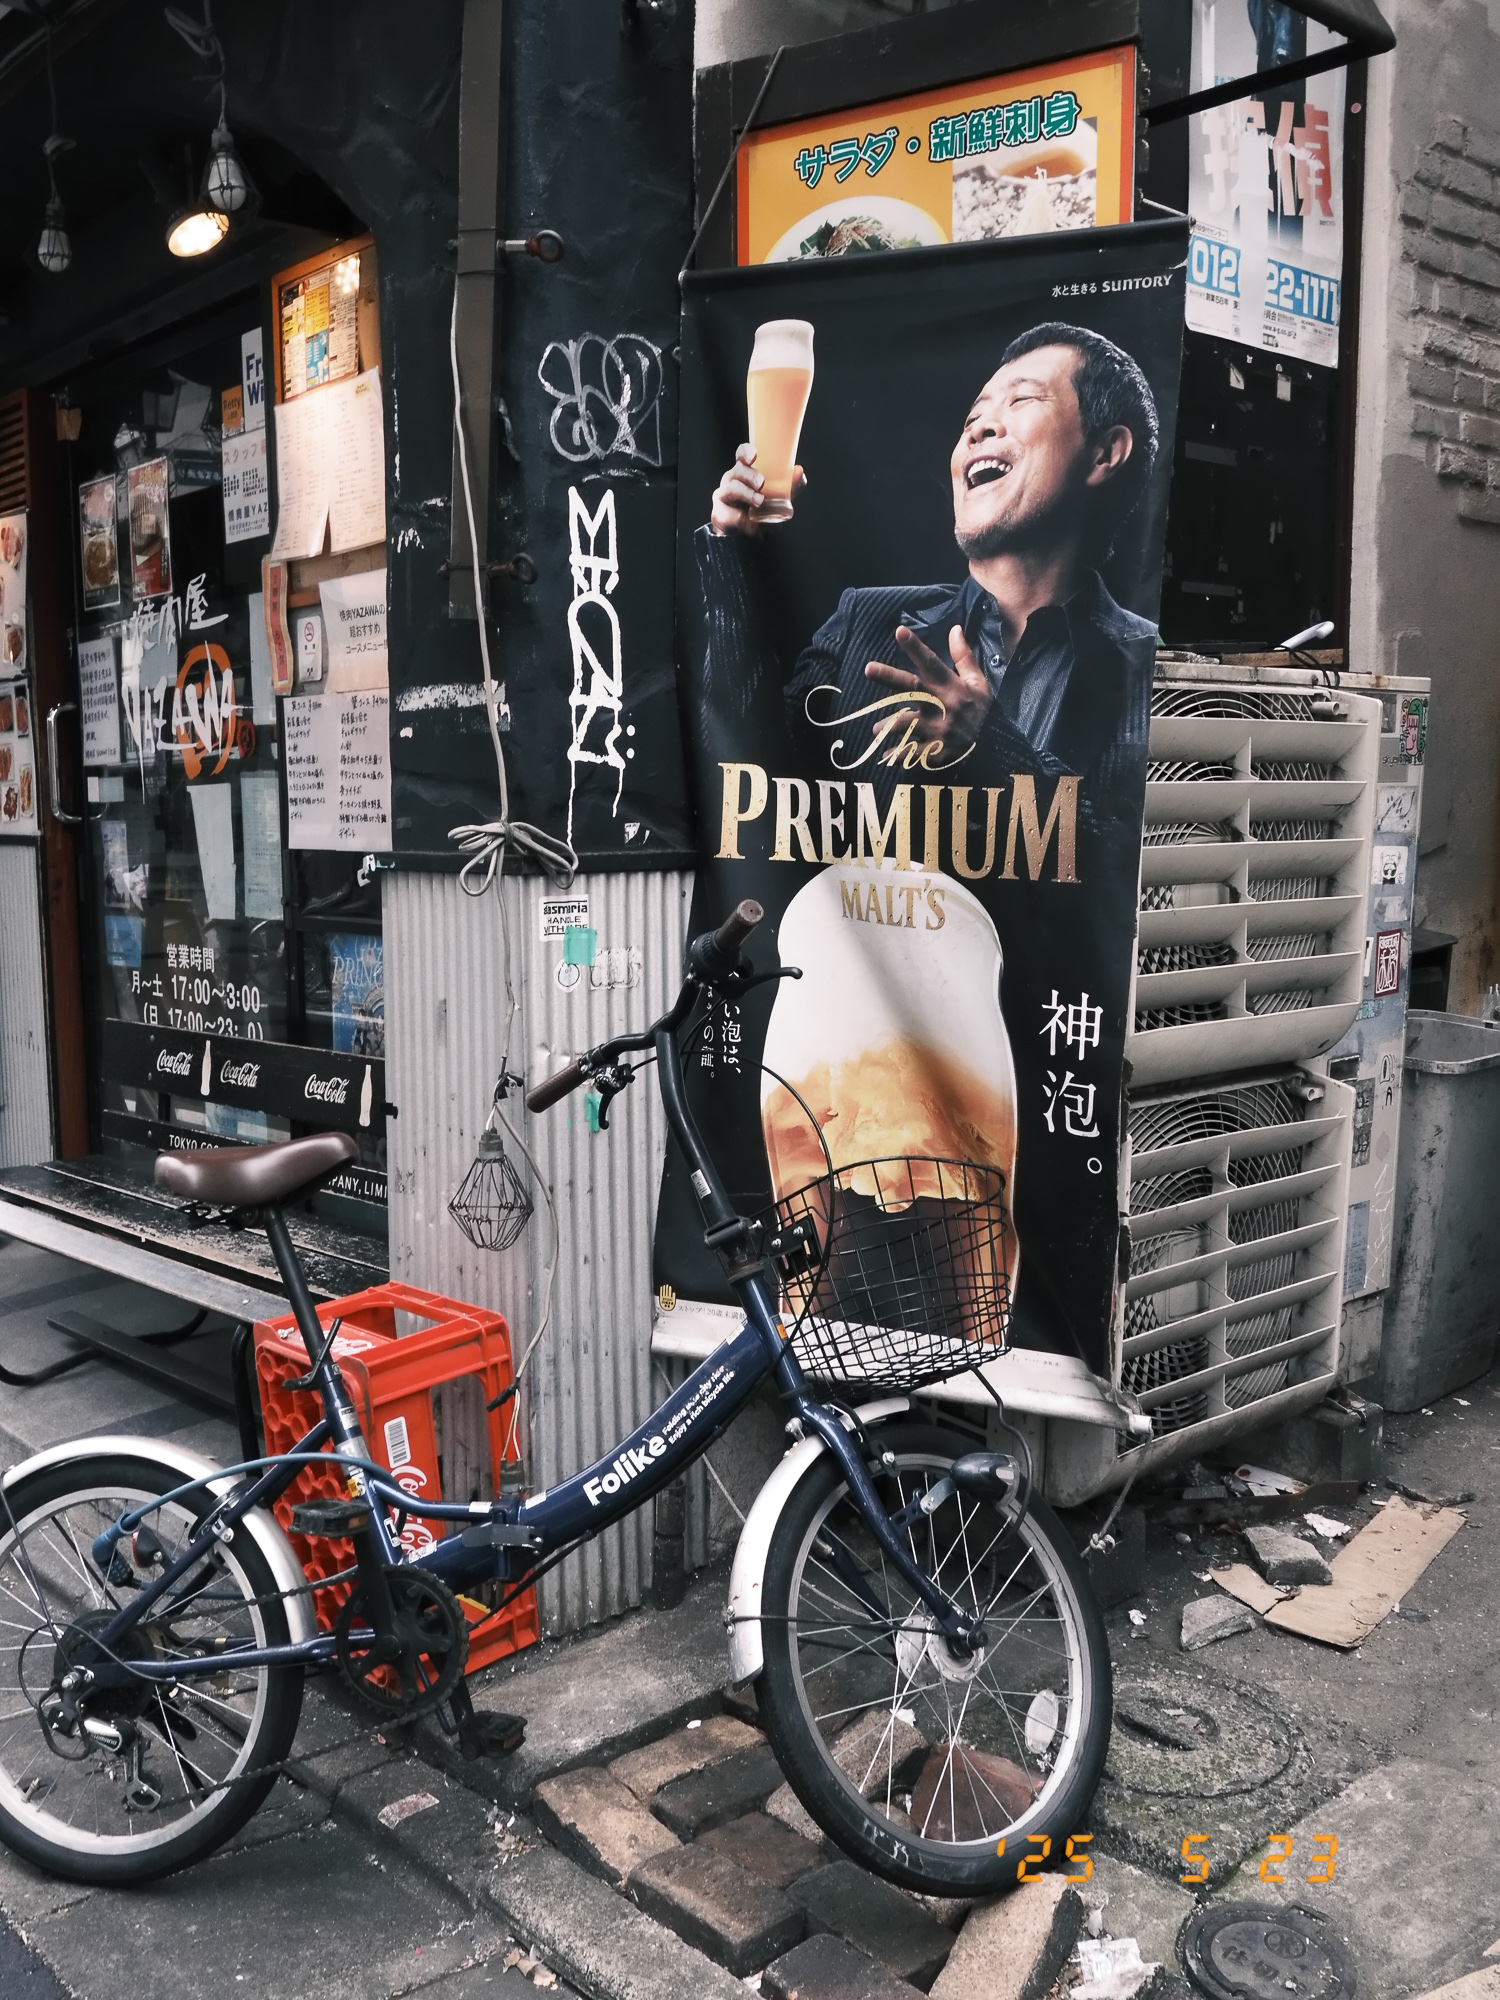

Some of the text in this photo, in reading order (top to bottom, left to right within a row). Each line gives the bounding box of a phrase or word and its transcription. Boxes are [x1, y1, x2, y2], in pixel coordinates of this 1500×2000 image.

[795, 91, 1080, 189] サラダ・新鮮刺身
[1052, 274, 1174, 298] 水と生きる SUNTORY
[340, 604, 385, 621] 焼肉YAZAWAの
[350, 622, 380, 638] 超おすすめ
[805, 684, 976, 771] The
[713, 762, 1084, 883] PREMIUM
[839, 878, 947, 931] MALT'S
[166, 944, 215, 973] 営業時間
[1039, 989, 1103, 1174] 神泡。
[328, 1176, 361, 1195] PANY,
[662, 1408, 687, 1435] Folding
[668, 1423, 687, 1444] Enjoy
[701, 1382, 724, 1408] bicycle
[582, 1434, 668, 1507] Folike
